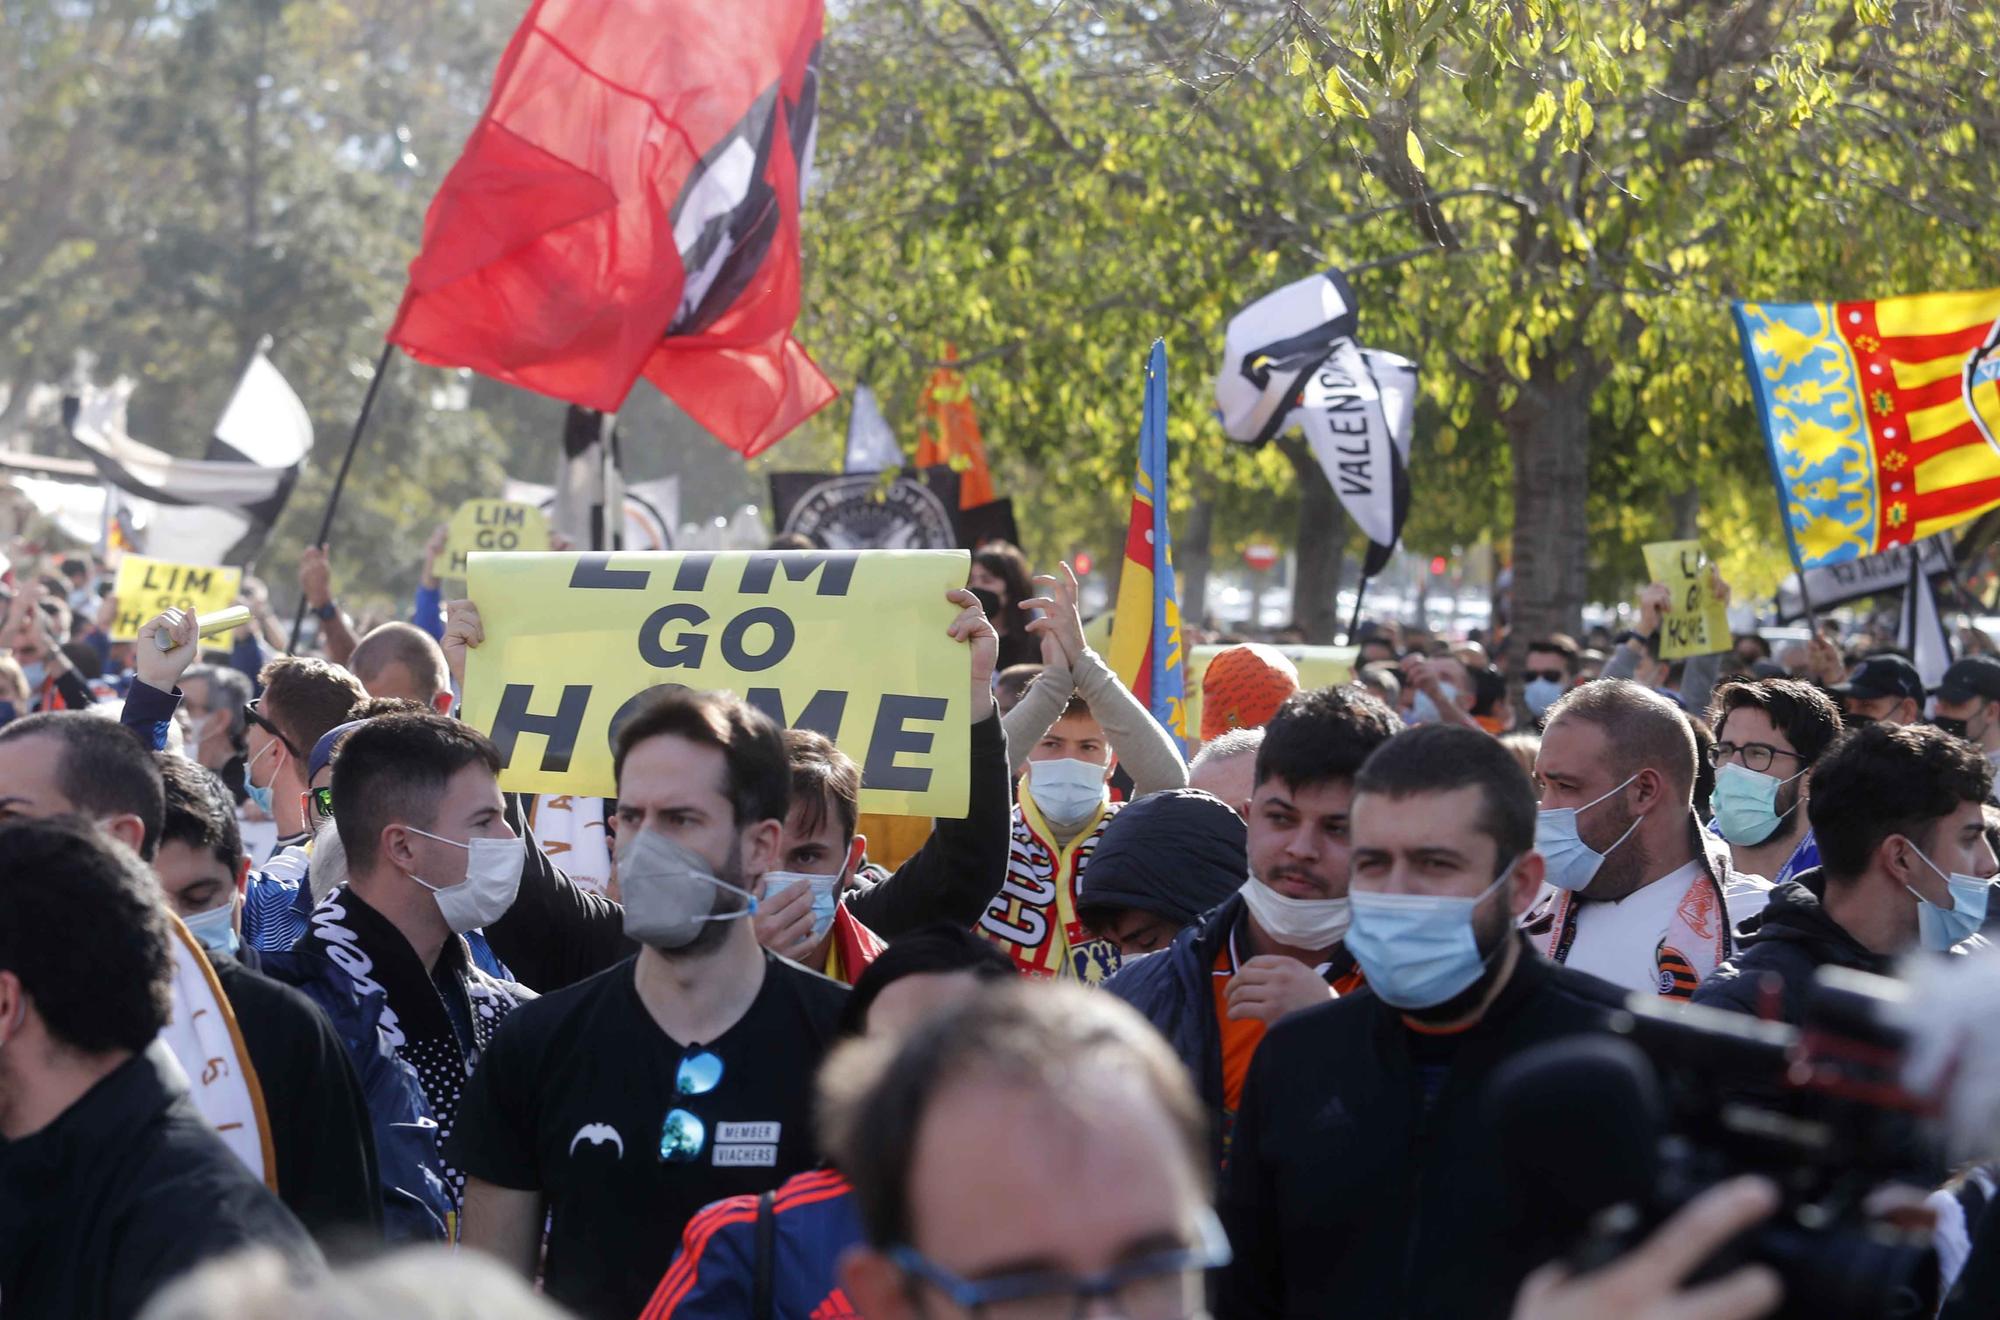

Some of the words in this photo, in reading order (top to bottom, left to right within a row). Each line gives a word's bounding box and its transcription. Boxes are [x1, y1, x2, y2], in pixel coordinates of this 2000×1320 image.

[475, 506, 524, 527] LIM
[476, 529, 518, 550] GO
[142, 565, 213, 592] LIM
[569, 552, 860, 596] LIM
[156, 596, 194, 610] GO
[638, 603, 795, 672] GO
[724, 1126, 771, 1138] MEMBER
[717, 1149, 771, 1162] VIACHERS
